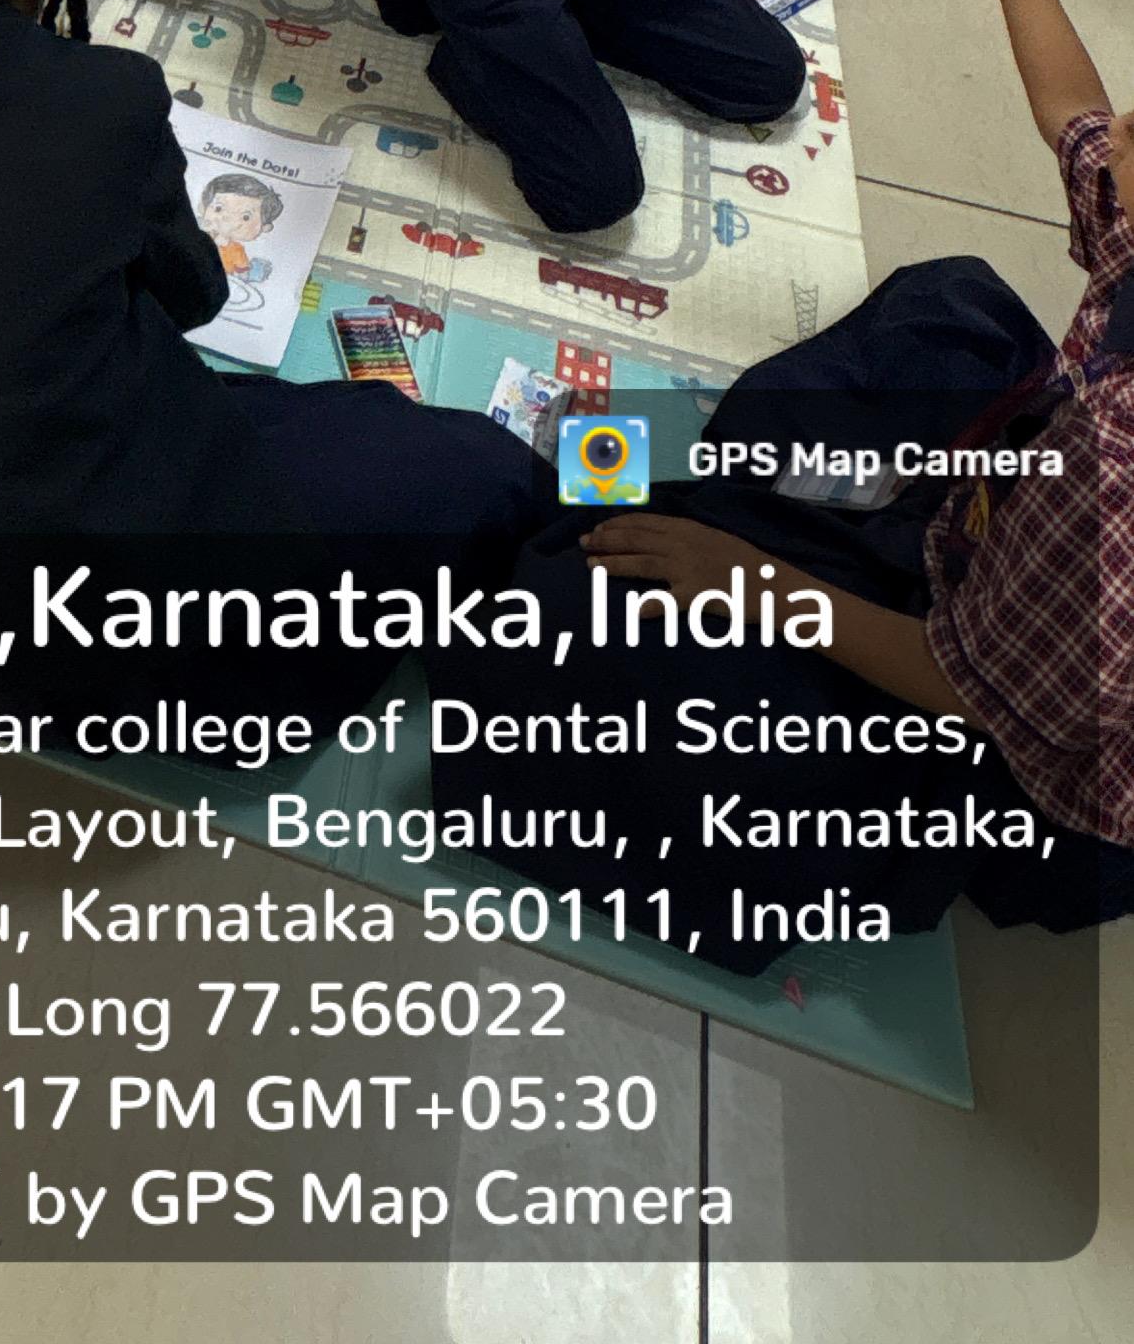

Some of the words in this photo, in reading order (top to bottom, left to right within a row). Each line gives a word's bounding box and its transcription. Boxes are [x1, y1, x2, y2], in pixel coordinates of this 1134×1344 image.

[203, 141, 233, 159] Join
[237, 152, 258, 167] the
[262, 159, 300, 178] Dots!
